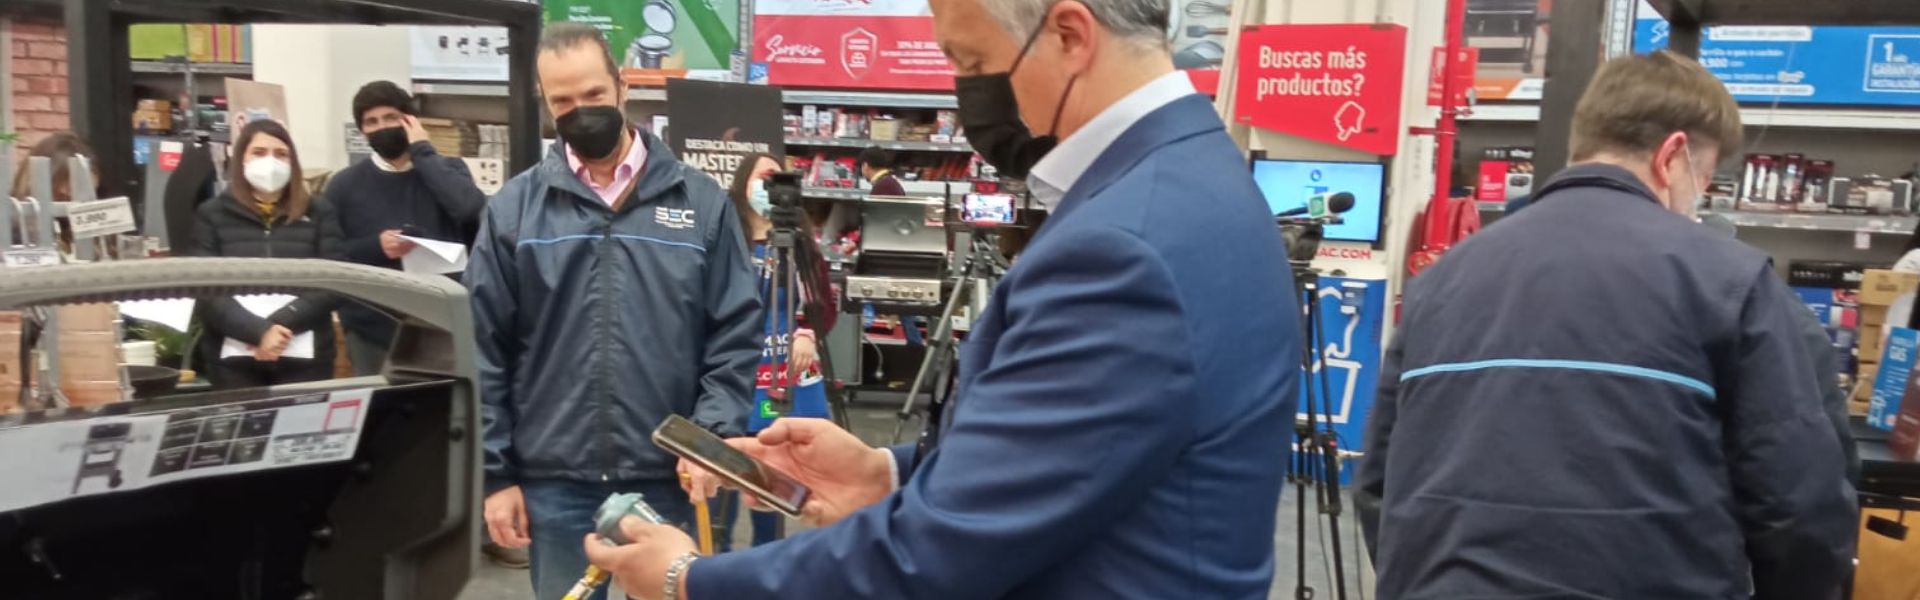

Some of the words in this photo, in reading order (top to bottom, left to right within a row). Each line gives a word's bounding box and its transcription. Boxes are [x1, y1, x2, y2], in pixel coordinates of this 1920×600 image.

[1259, 45, 1322, 69] Buscas
[1327, 45, 1367, 69] más
[1257, 72, 1365, 101] productos?
[655, 206, 695, 224] SEC
[1313, 246, 1372, 260] AC.COM
